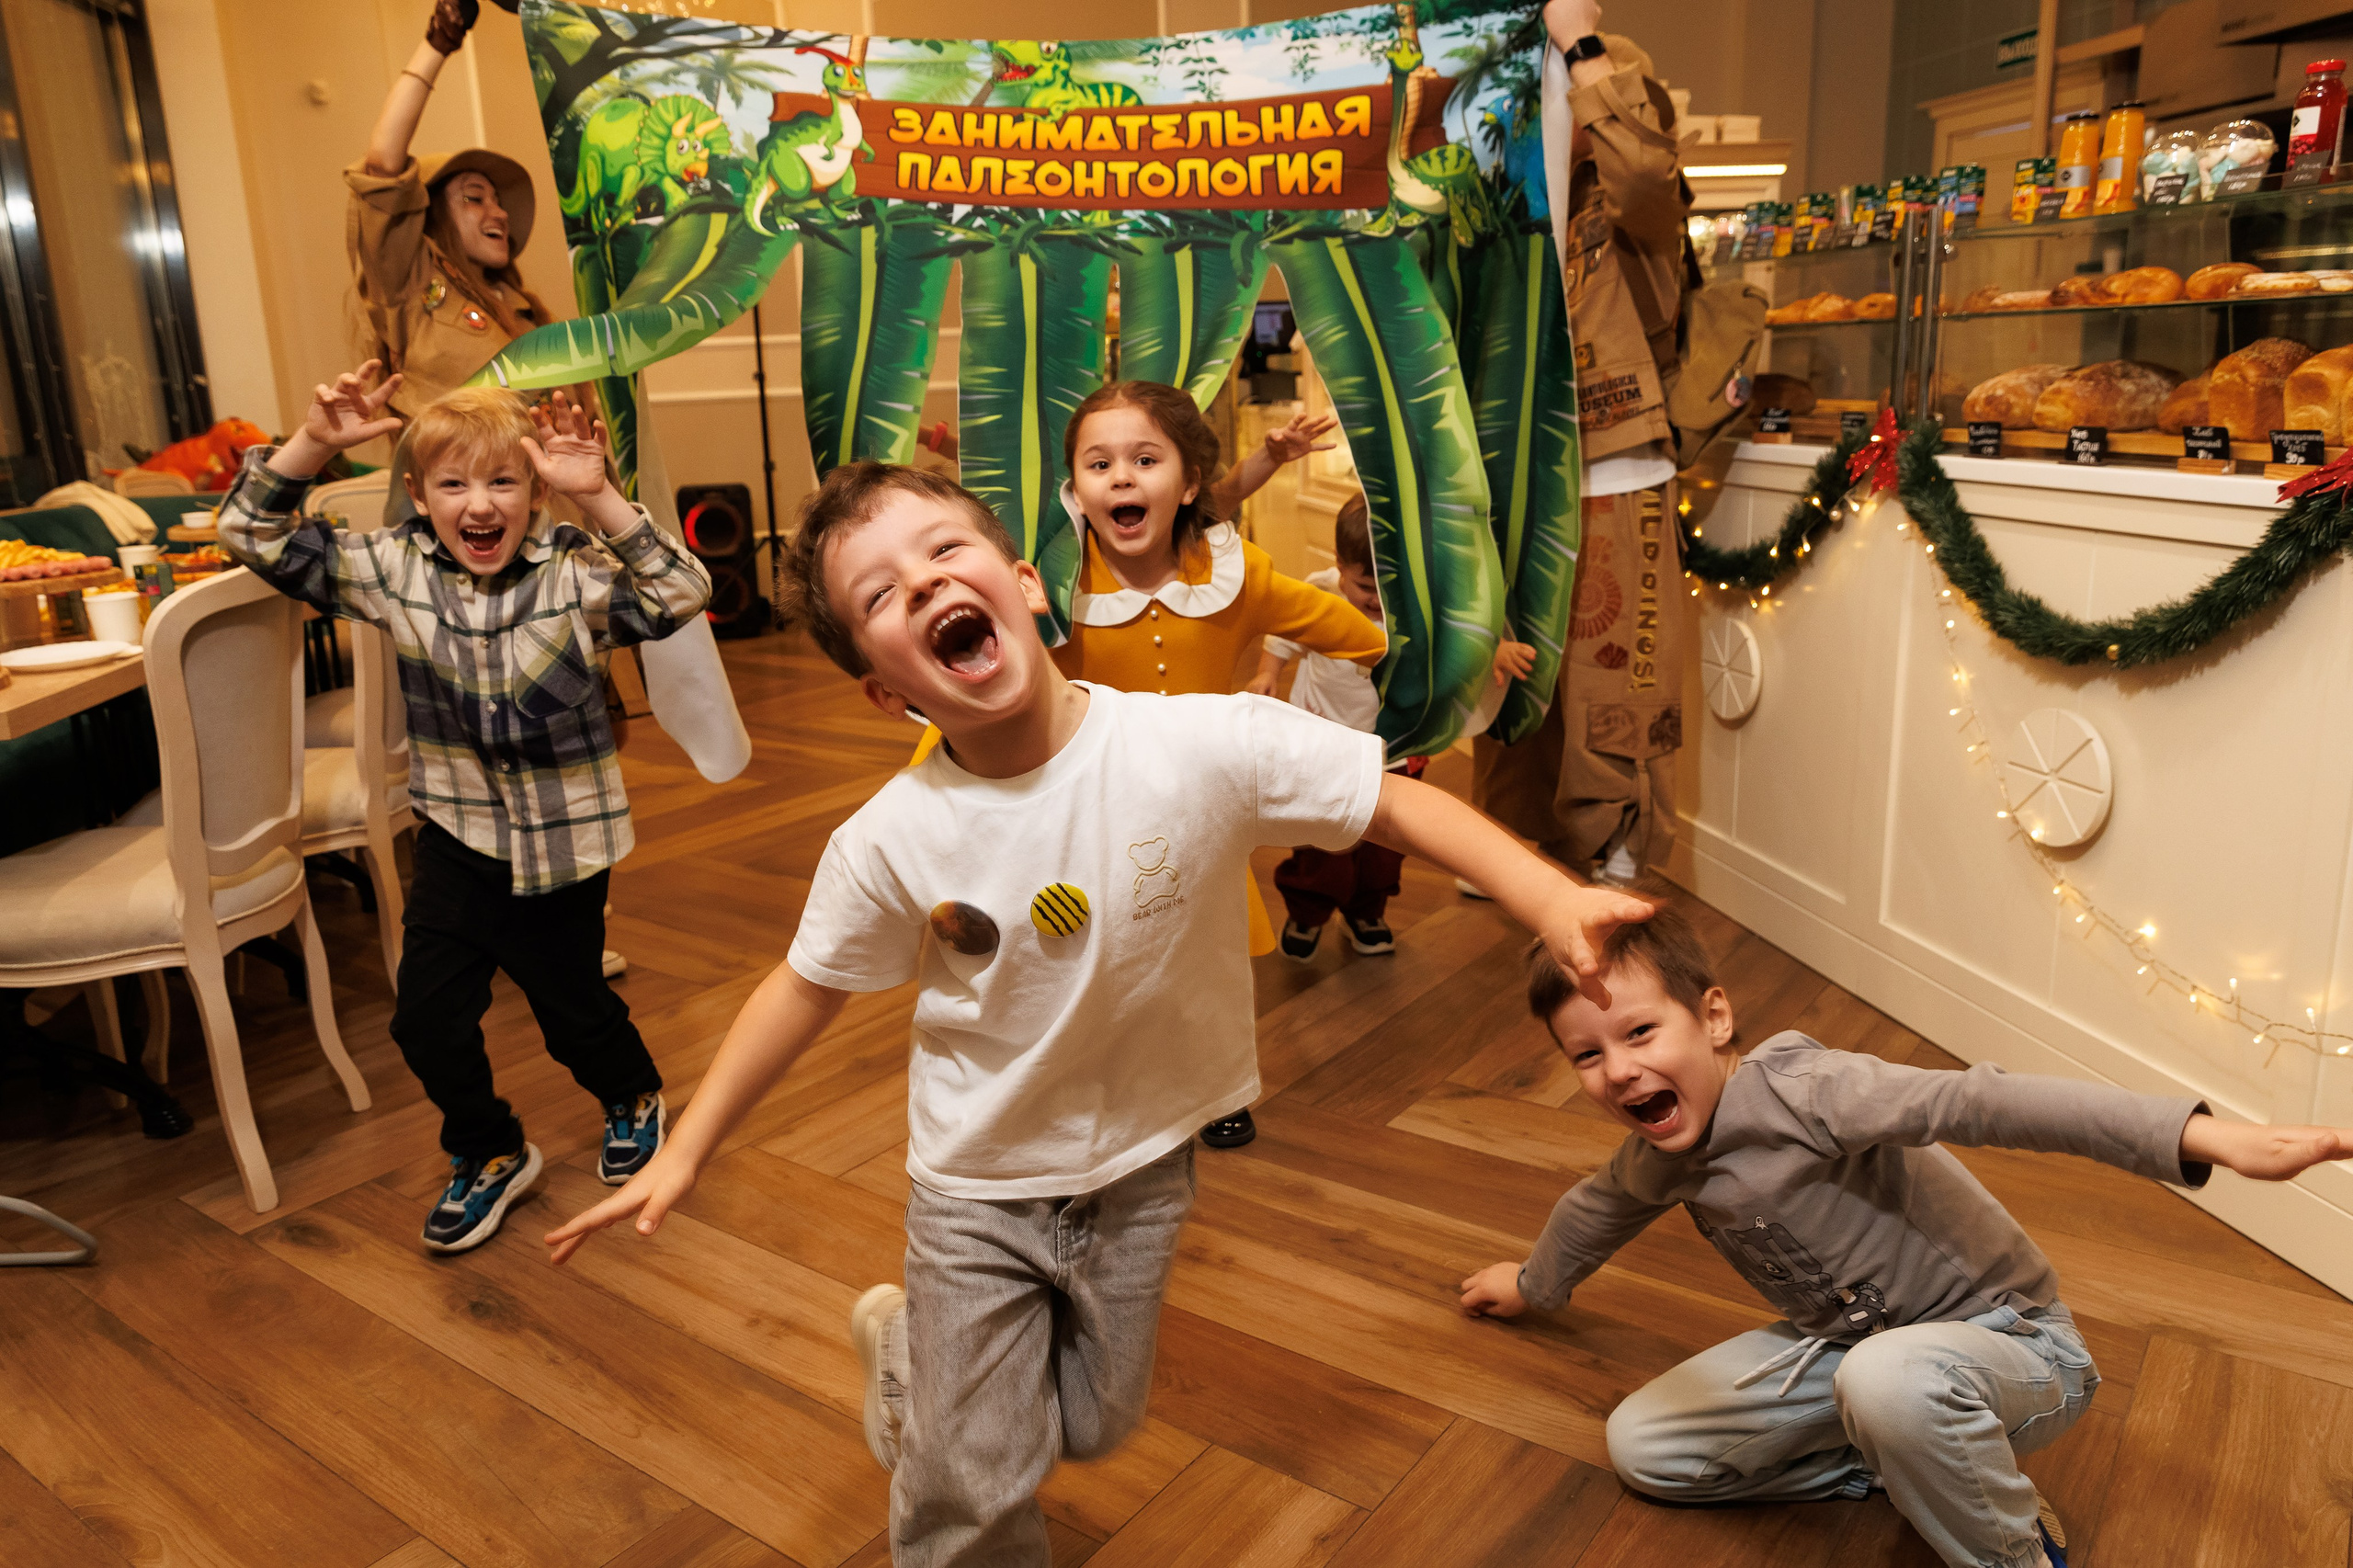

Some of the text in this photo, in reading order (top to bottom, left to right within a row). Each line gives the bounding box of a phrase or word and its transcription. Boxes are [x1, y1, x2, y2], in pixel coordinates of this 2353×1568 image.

[889, 95, 1371, 151] ЗАНИМАТЕЛЬНАЯ
[897, 148, 1344, 198] ПАЛЕОНТОЛОГИЯ
[1578, 386, 1642, 413] USEUM
[1132, 909, 1151, 921] BEAR
[1153, 901, 1172, 914] WITH
